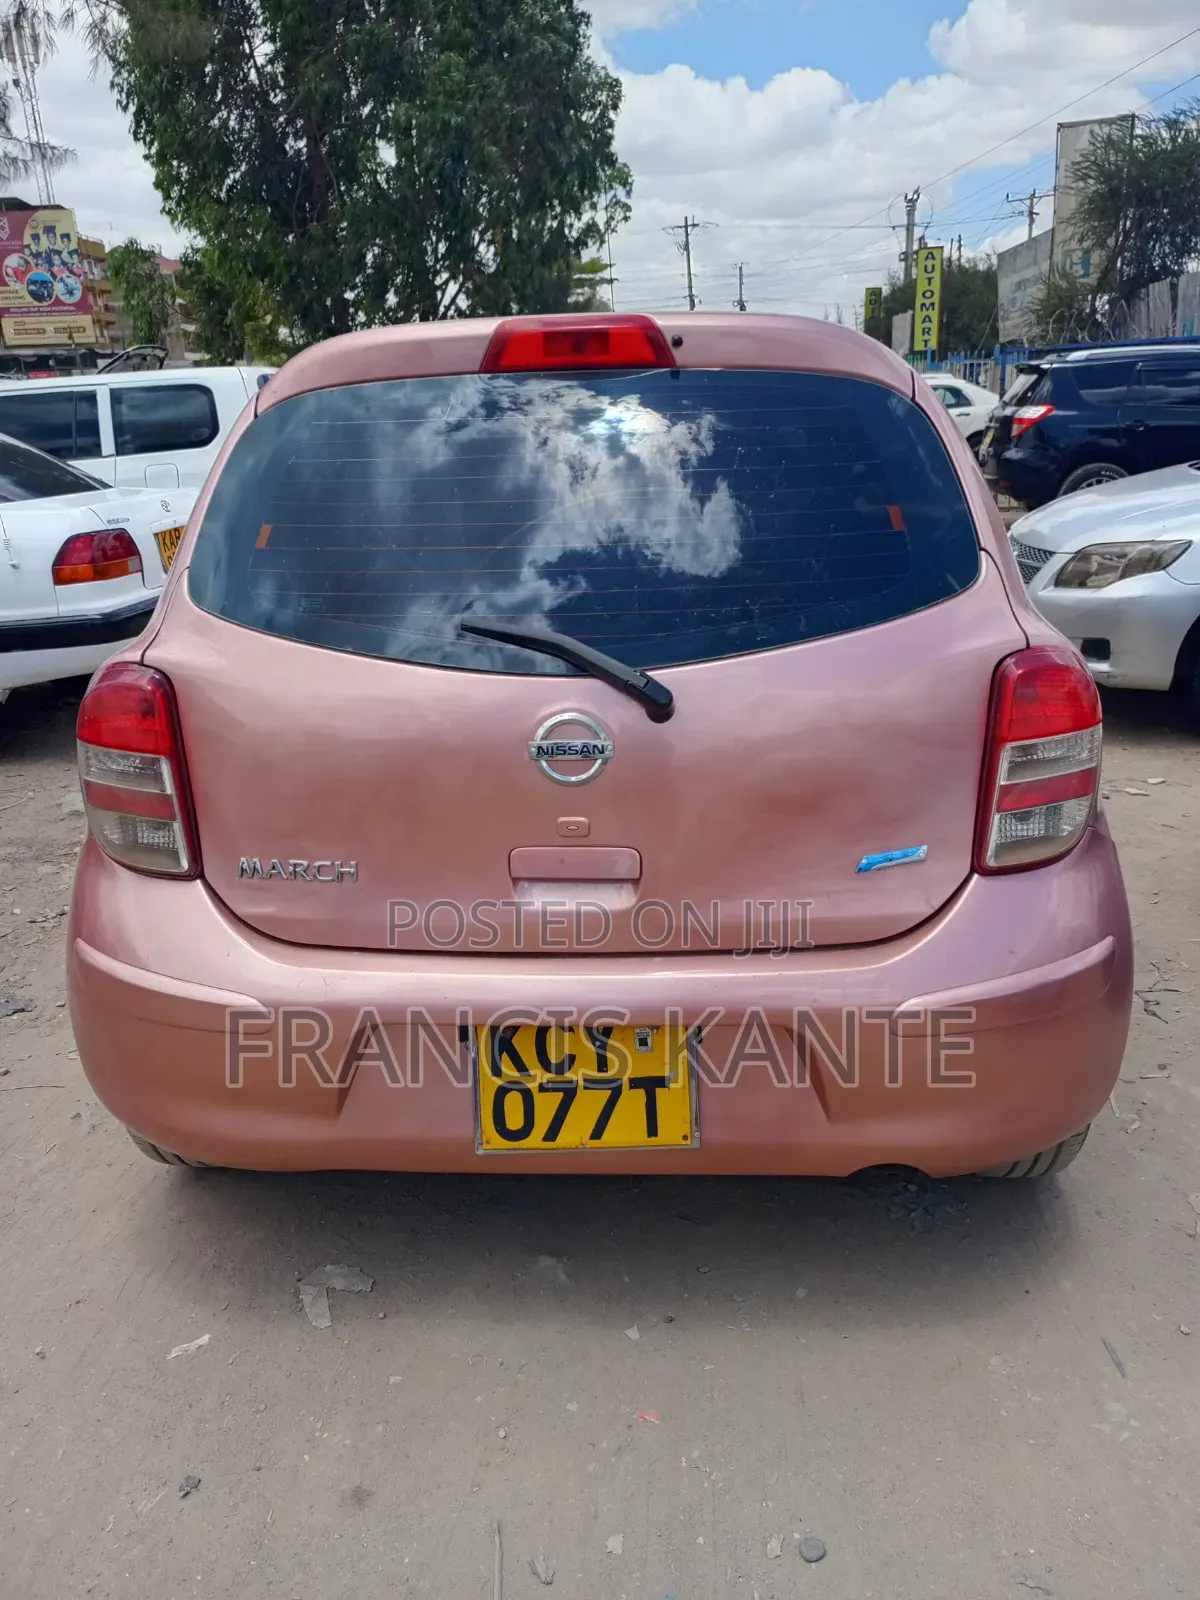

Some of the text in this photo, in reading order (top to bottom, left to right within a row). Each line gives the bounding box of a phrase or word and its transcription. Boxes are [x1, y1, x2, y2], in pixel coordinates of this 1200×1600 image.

[920, 251, 936, 348] AUTOMART
[537, 744, 605, 756] NISSAN
[238, 857, 358, 882] MARCH
[491, 1026, 613, 1078] KCY
[492, 1075, 671, 1143] 077T
